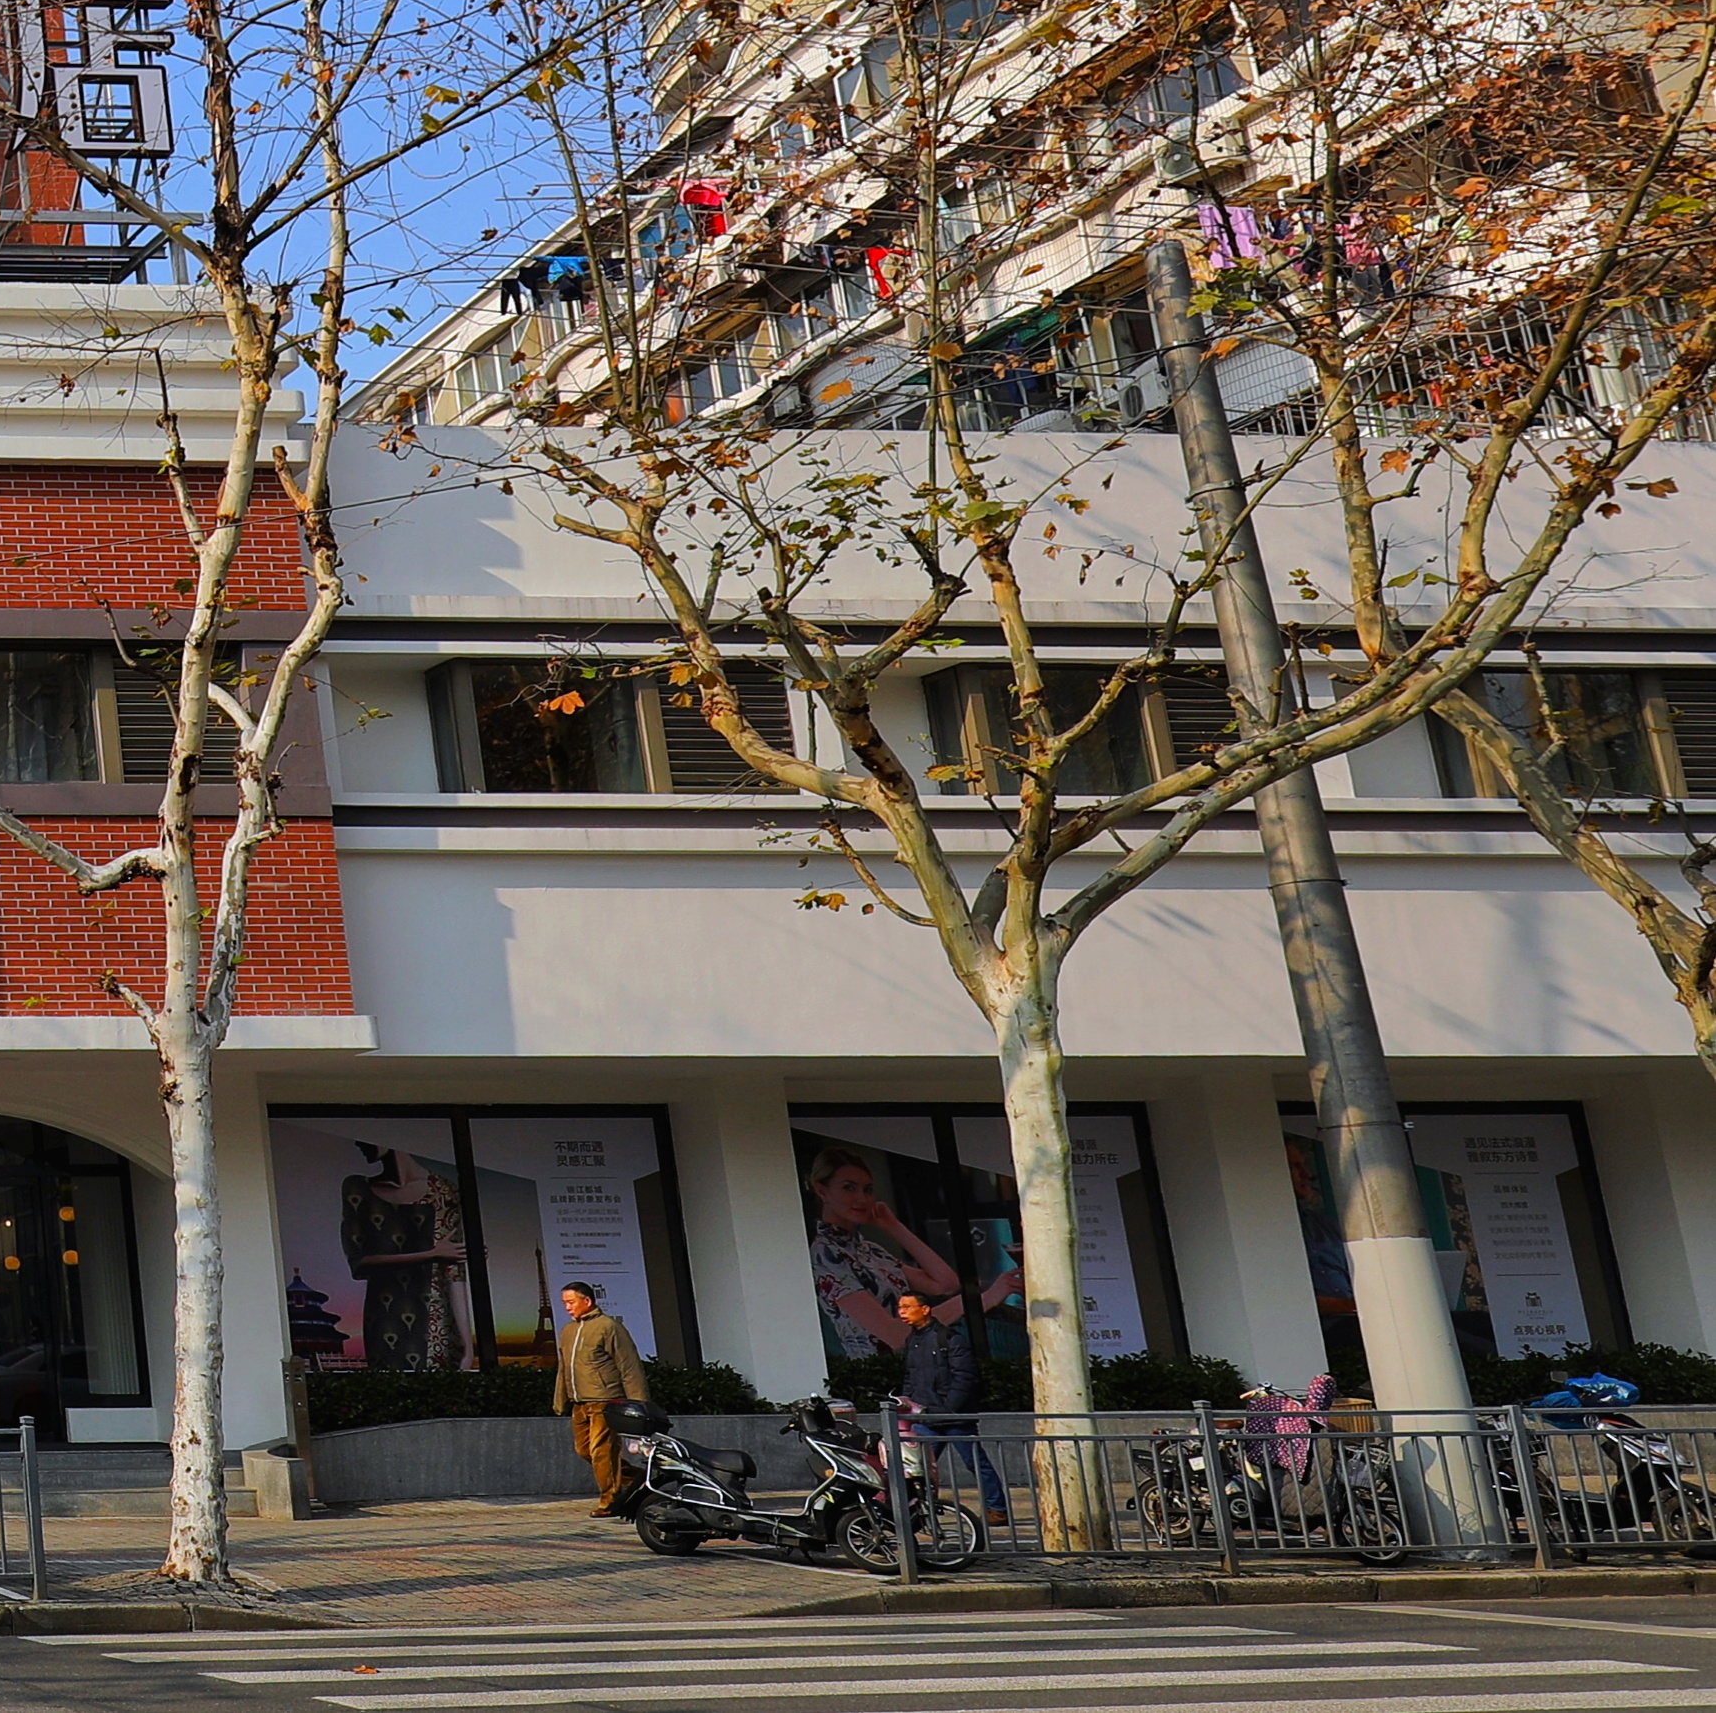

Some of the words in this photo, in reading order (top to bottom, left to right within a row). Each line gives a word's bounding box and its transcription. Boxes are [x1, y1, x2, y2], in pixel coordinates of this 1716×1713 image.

[554, 1141, 604, 1153] 不期而遇
[556, 1155, 606, 1167] 灵感汇聚
